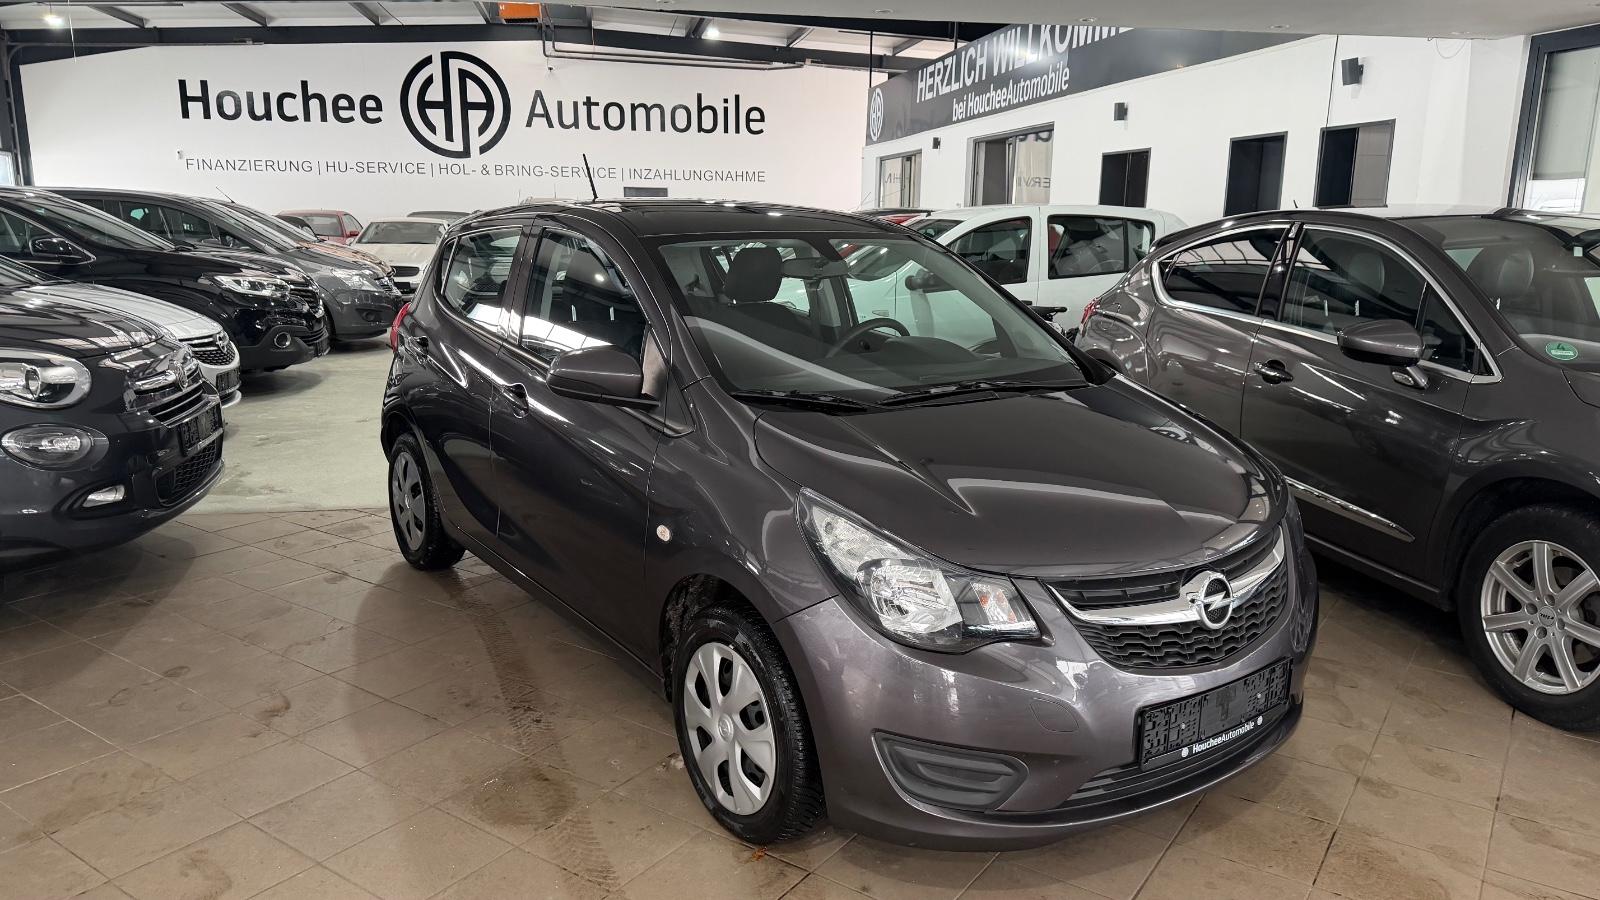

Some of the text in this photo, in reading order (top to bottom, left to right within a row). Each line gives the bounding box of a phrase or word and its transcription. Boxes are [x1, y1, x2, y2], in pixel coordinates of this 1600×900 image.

[916, 41, 988, 103] HERZLICH
[952, 61, 1070, 122] bei HoucheeAutomobile
[178, 79, 383, 124] Houchee
[525, 89, 766, 136] Automobile
[185, 158, 766, 183] FINANZIERUNG HU-SERVICE HOL- & BRING-SERVICE INZAHLUNGNAHME
[1193, 721, 1255, 754] HoucheeAutomobile
